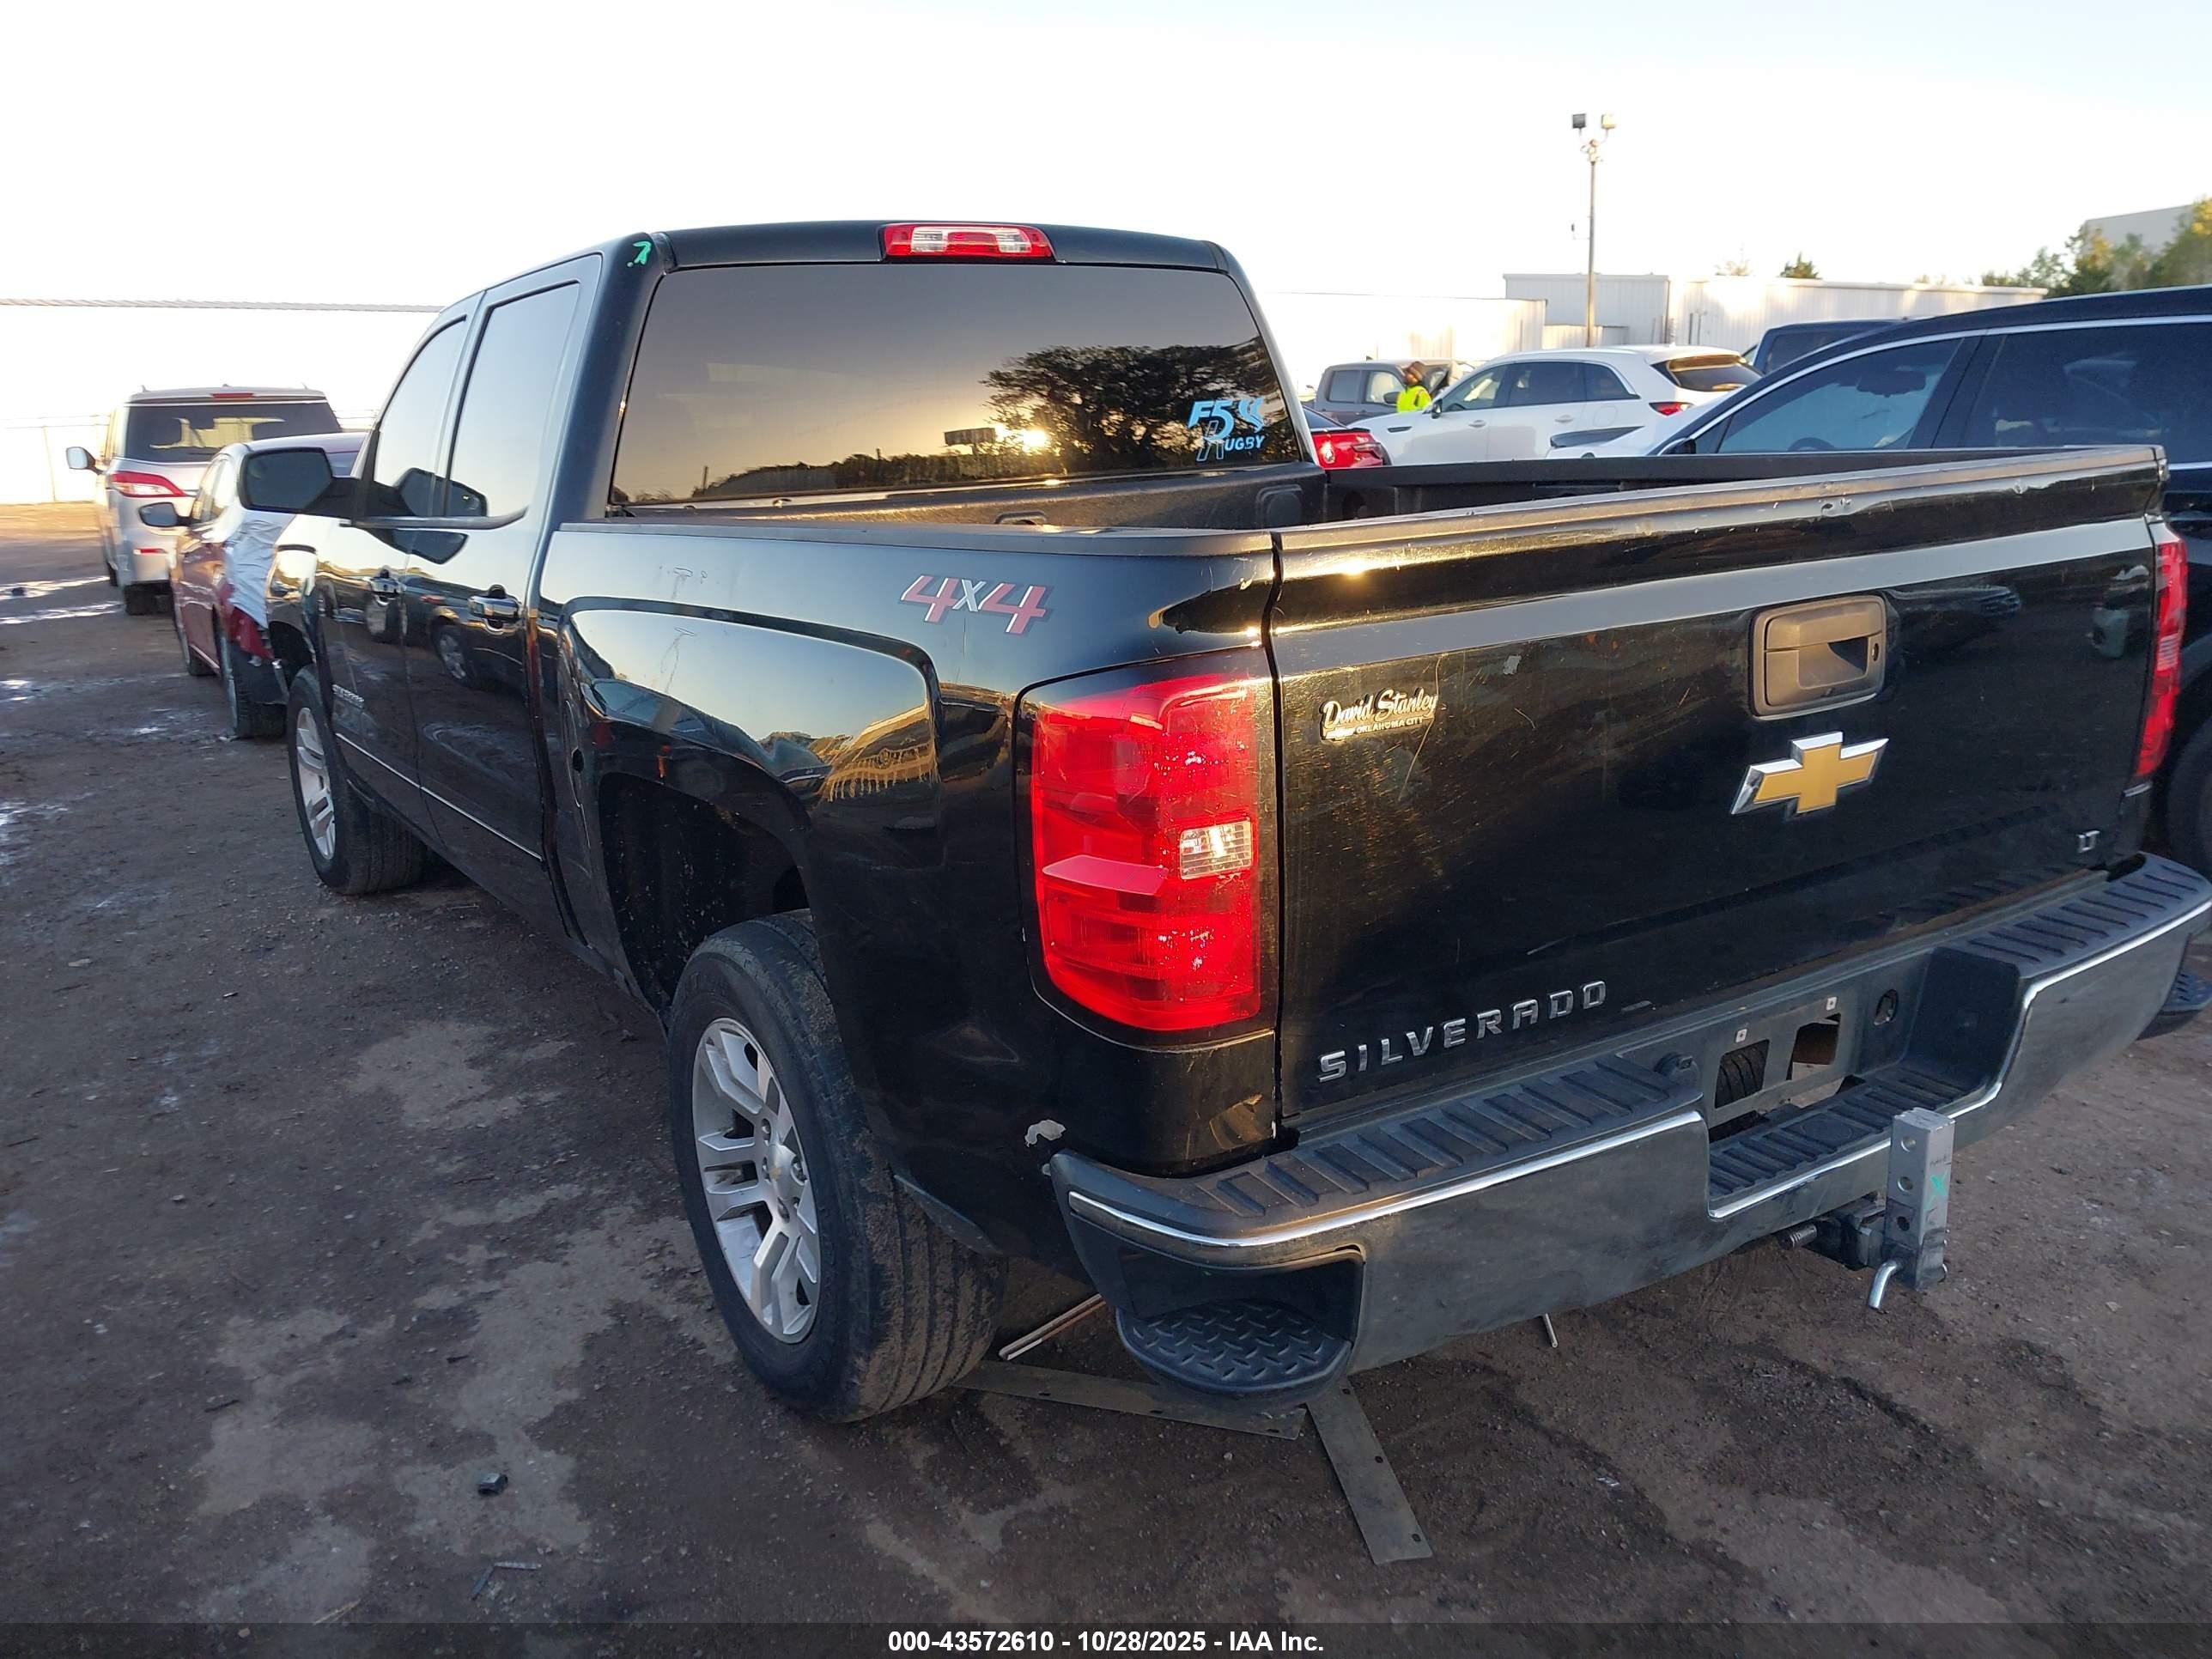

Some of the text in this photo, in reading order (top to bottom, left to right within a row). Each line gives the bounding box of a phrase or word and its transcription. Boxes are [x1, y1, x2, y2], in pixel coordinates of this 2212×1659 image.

[1322, 687, 1438, 729] David Stanley
[1355, 719, 1406, 734] OKLAHOMA
[1406, 715, 1425, 727] CITY
[2077, 830, 2100, 854] LT
[1318, 980, 1607, 1083] SILVERADO
